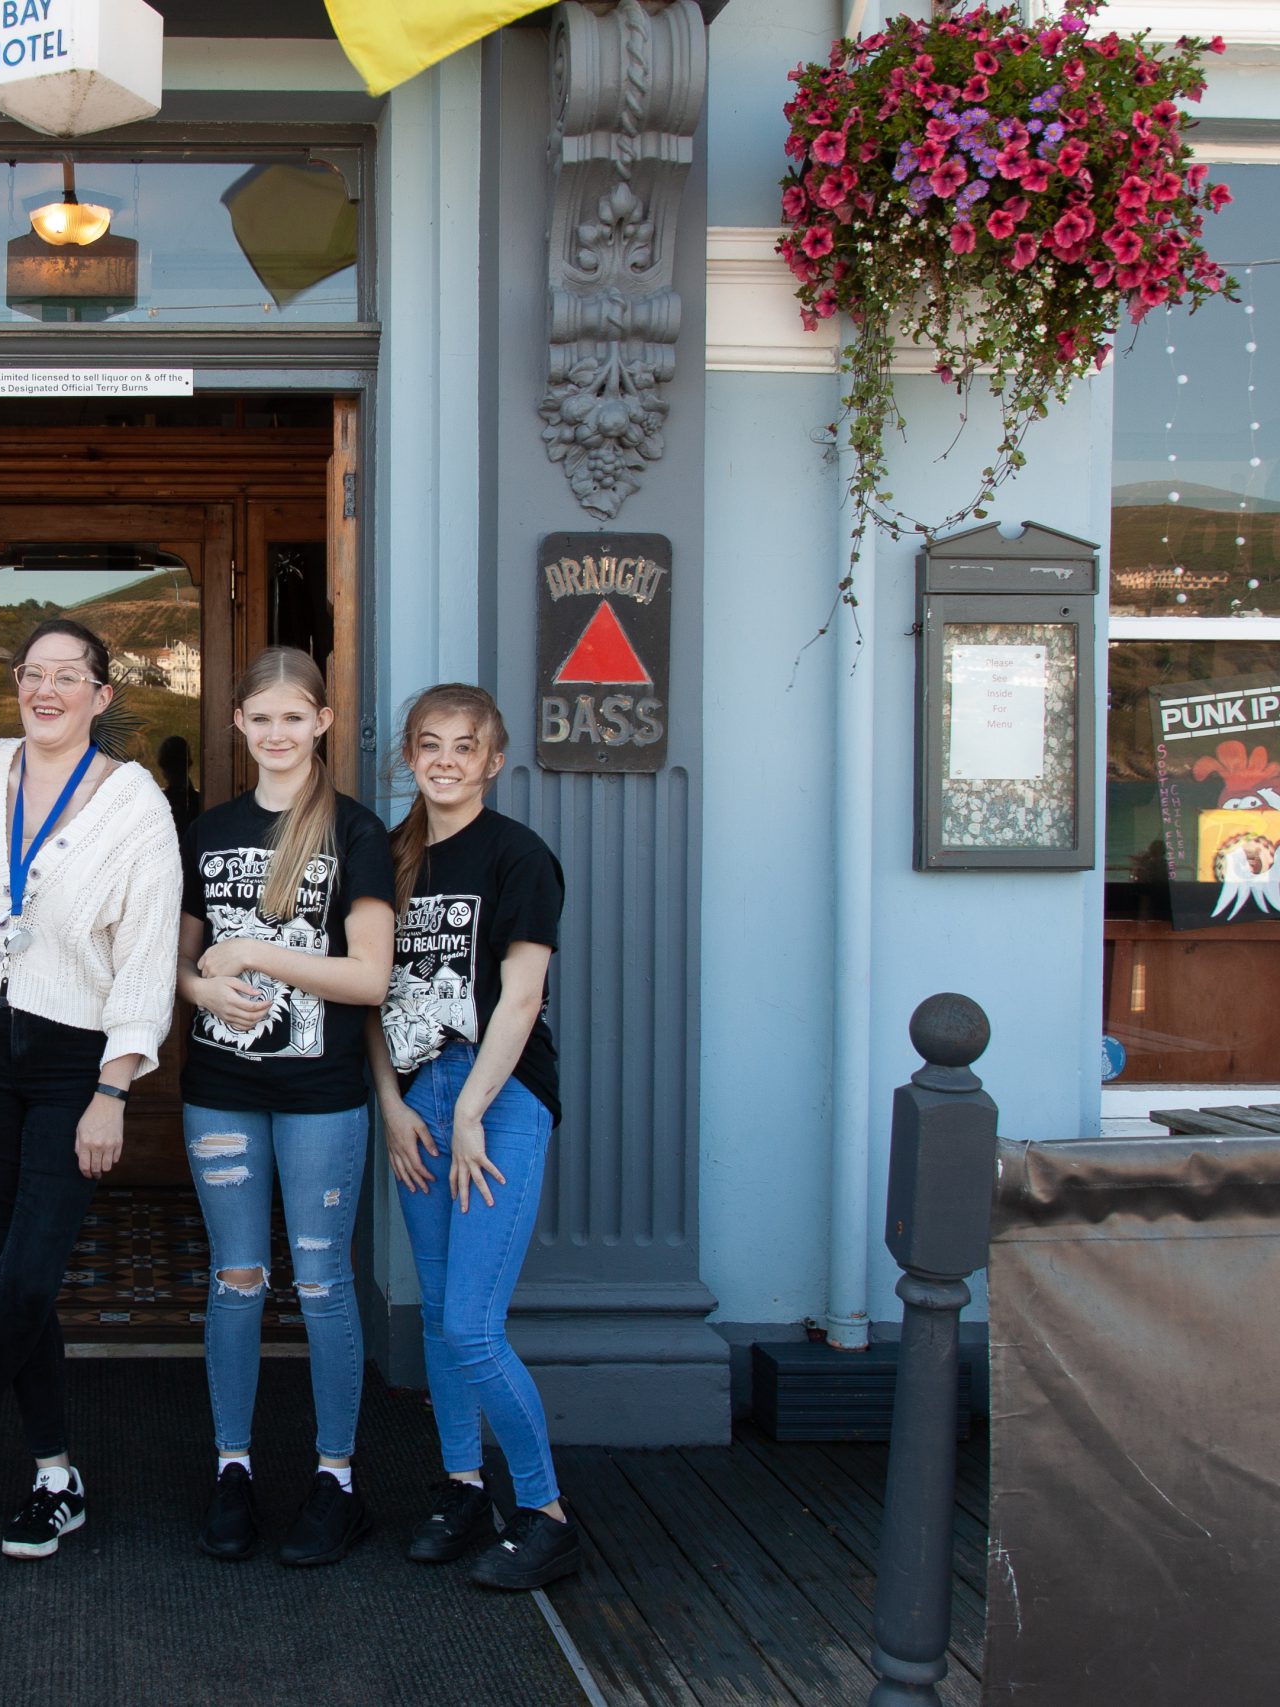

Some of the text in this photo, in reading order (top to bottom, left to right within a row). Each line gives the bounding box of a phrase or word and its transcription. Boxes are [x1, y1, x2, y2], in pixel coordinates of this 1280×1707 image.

[2, 0, 51, 28] BAY
[31, 373, 69, 381] licensed
[72, 373, 81, 381] to
[83, 373, 99, 381] sell
[101, 373, 127, 383] liquor
[144, 373, 151, 381] &
[154, 373, 166, 381] off
[169, 373, 183, 381] the
[8, 384, 59, 394] Designated
[61, 383, 93, 391] Official
[96, 383, 119, 393] Terry
[121, 383, 149, 391] Burns
[544, 555, 669, 606] DRAUGHT
[986, 659, 1014, 667] Please
[991, 674, 1008, 682] See
[987, 690, 1013, 698] Inside
[992, 705, 1007, 713] For
[1161, 695, 1280, 732] PUNK IP
[541, 694, 664, 748] BASS
[987, 720, 1013, 728] Menu
[1157, 744, 1172, 824] SOUTHERN
[1170, 784, 1186, 860] CHICKEN
[205, 882, 232, 899] BACK
[236, 883, 254, 899] TO
[396, 903, 447, 934] ushy's
[395, 937, 411, 952] TO
[440, 947, 468, 963] (again)
